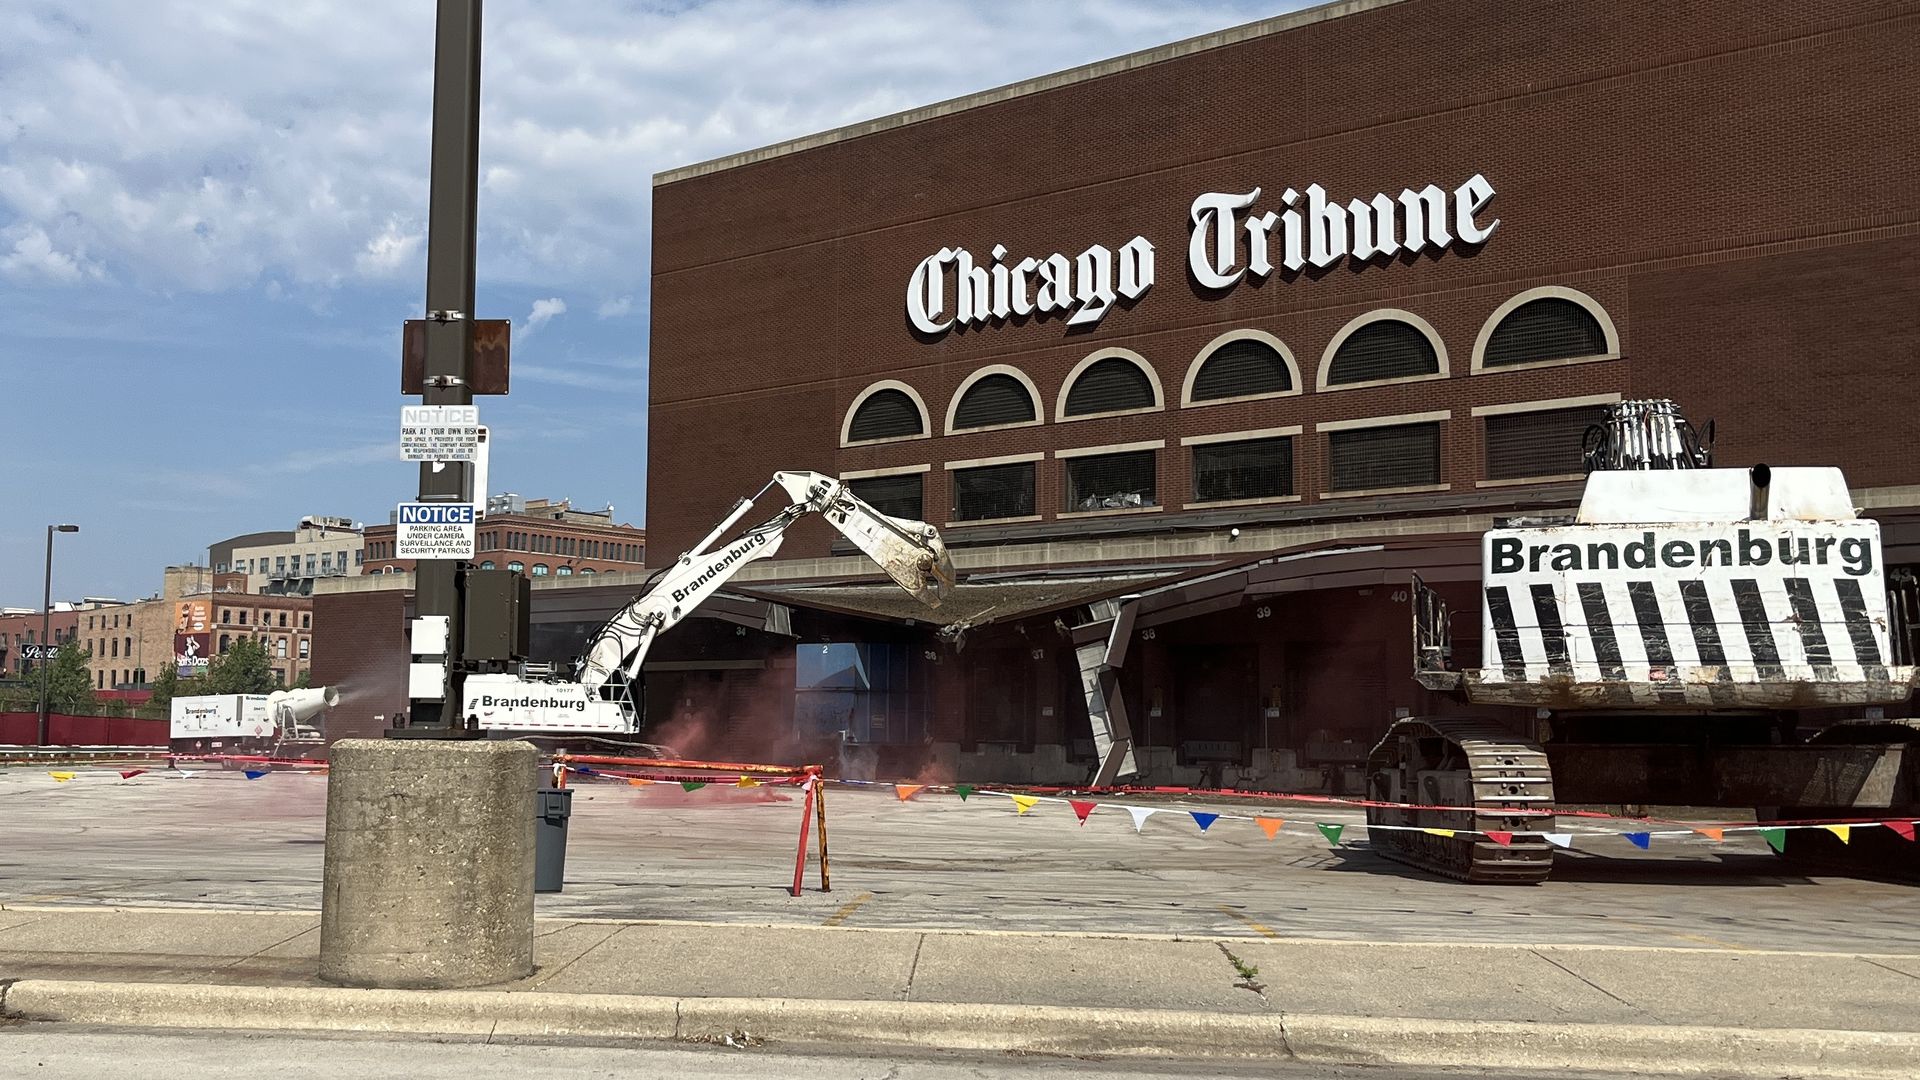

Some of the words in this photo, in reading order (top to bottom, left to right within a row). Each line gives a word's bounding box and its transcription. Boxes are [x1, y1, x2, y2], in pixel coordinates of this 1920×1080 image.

[906, 234, 1156, 335] Chicago
[1187, 172, 1501, 290] Tribune
[404, 410, 475, 423] NOTICE
[402, 507, 470, 522] NOTICE
[1490, 528, 1874, 577] Brandenburg
[671, 533, 766, 603] Brandenburg
[1391, 590, 1407, 602] 40
[1256, 606, 1271, 618] 39
[736, 626, 746, 636] 34
[1142, 628, 1156, 640] 38
[822, 645, 828, 654] 2
[1032, 648, 1044, 659] 37
[482, 695, 585, 712] Brandenburg
